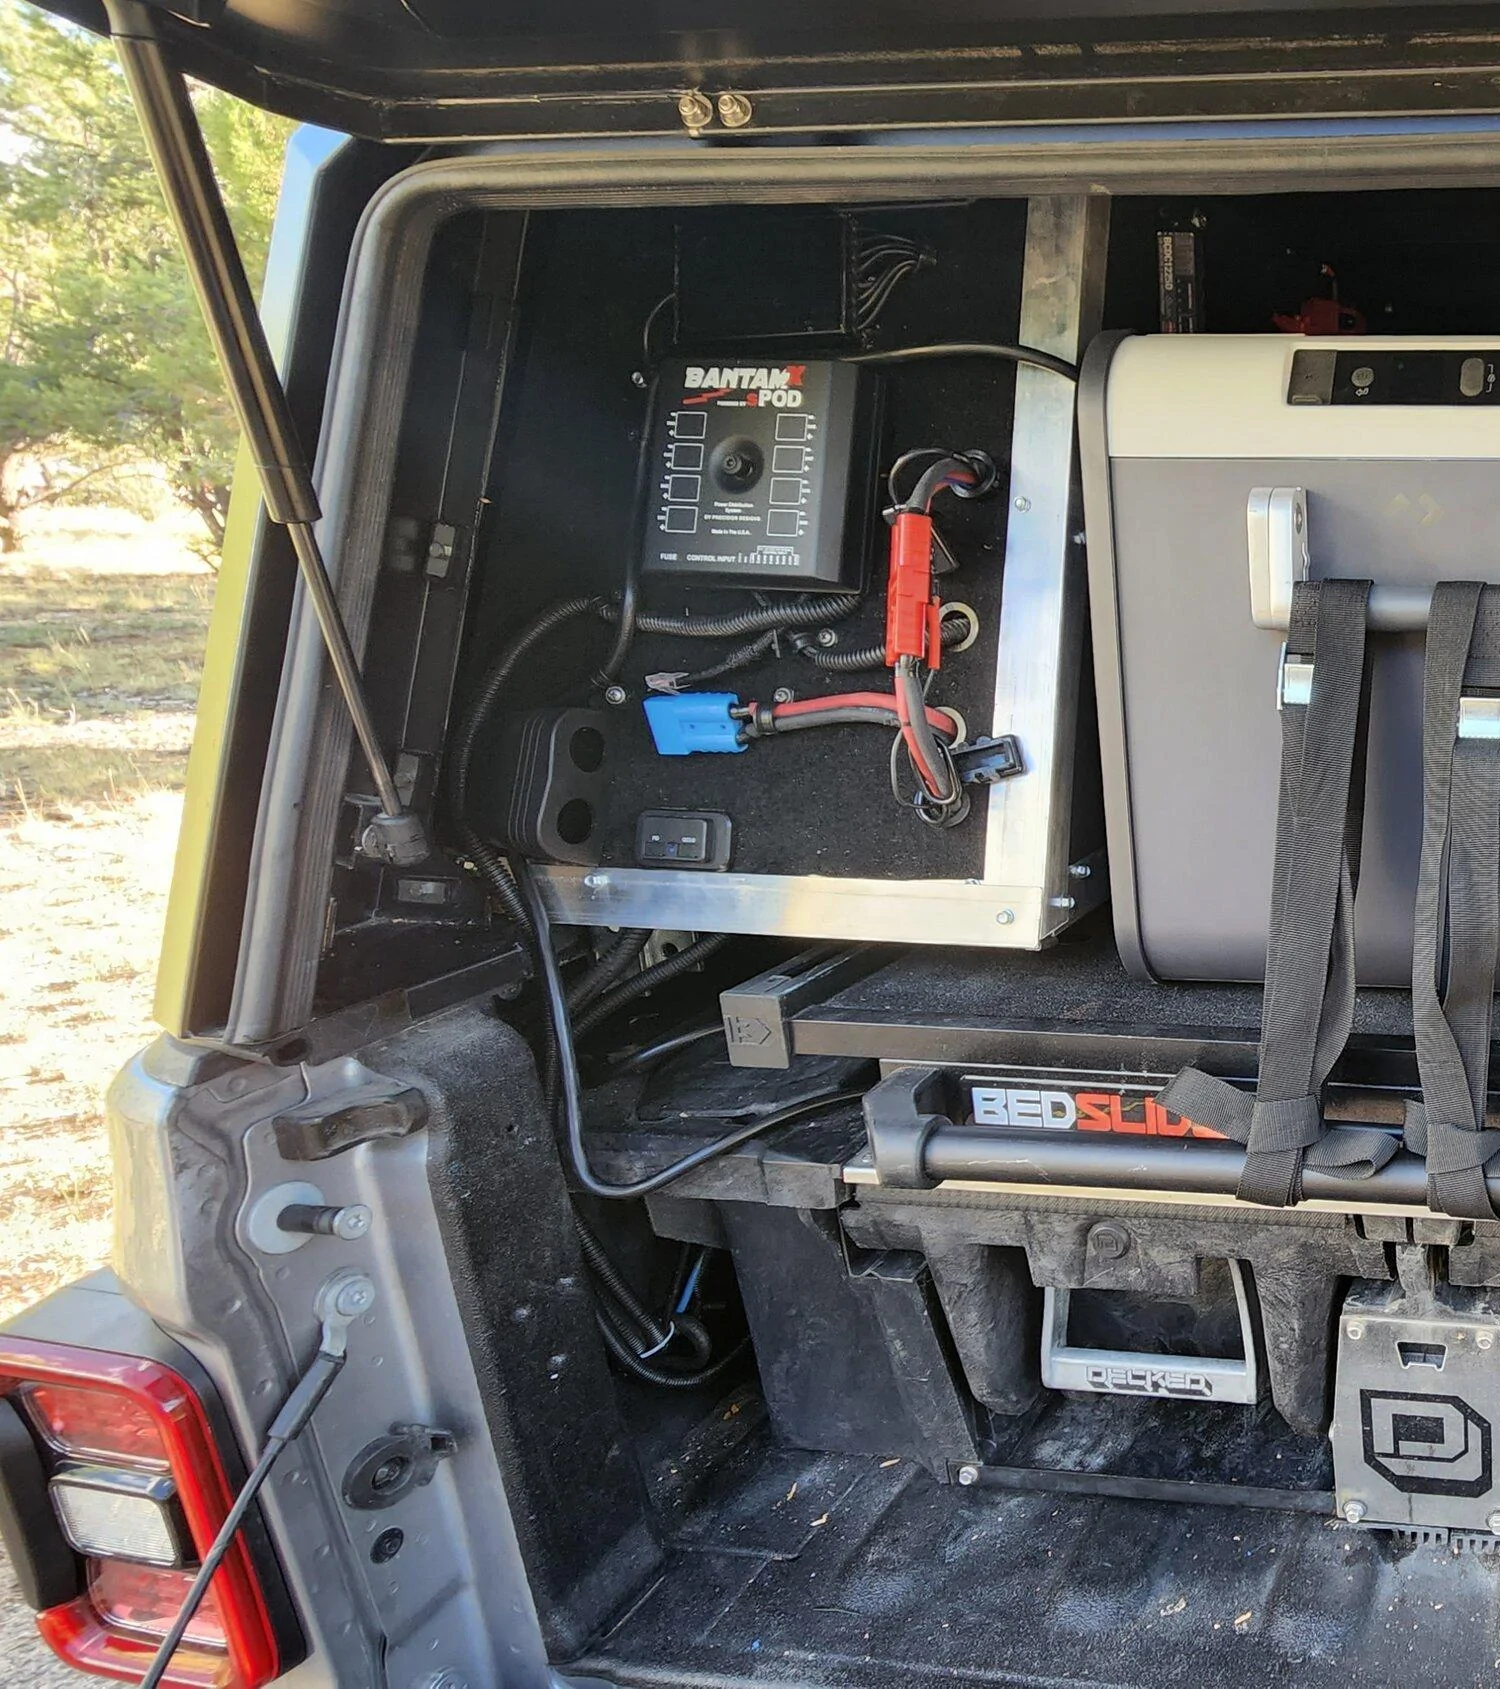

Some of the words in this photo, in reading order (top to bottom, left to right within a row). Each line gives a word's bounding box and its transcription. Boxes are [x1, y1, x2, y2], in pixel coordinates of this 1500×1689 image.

[686, 554, 717, 562] CONTROL
[971, 1086, 1230, 1139] BEDSLID
[1086, 1366, 1213, 1397] DECKED
